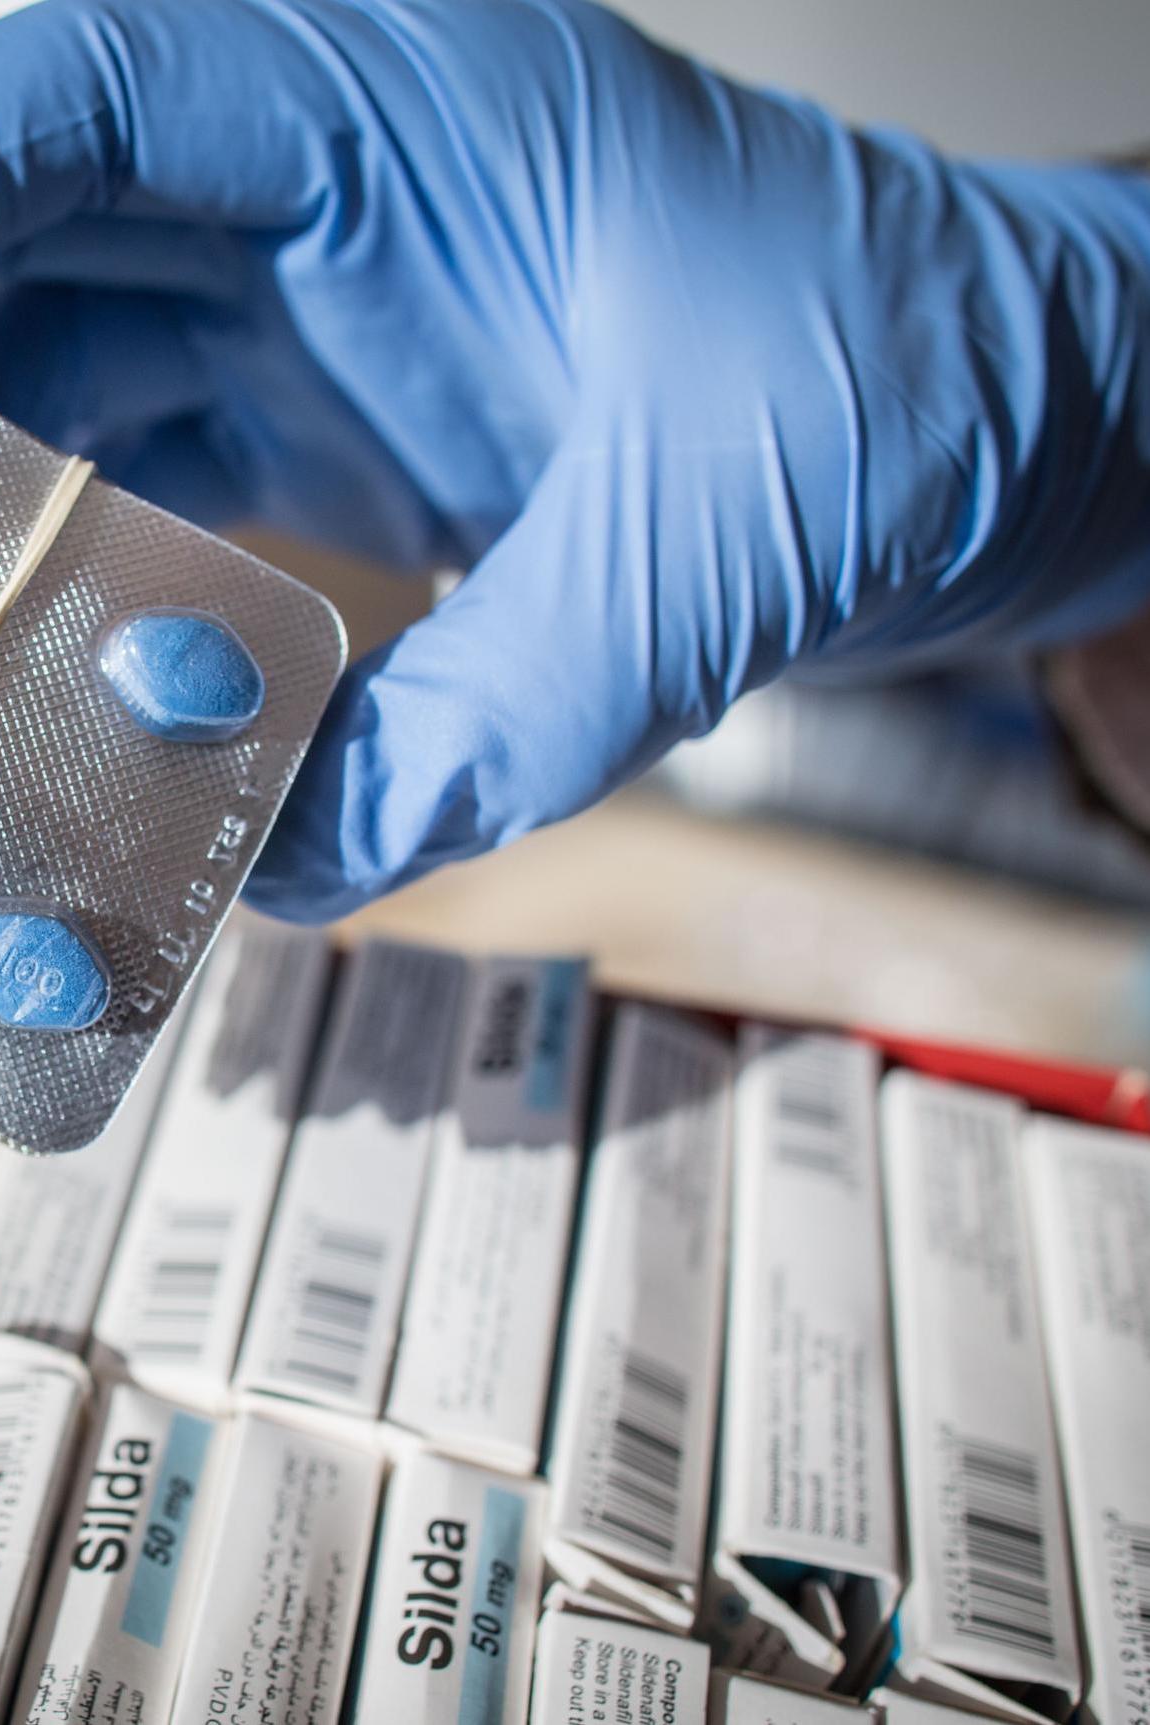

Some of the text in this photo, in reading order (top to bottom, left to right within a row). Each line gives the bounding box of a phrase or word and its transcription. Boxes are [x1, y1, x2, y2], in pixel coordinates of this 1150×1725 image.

[72, 1438, 153, 1573] Silda
[142, 1475, 192, 1567] 50 mg
[397, 1518, 468, 1671] Silda
[470, 1559, 516, 1657] 50 mg
[569, 1636, 592, 1681] Keep
[569, 1685, 585, 1712] out
[593, 1641, 614, 1721] Store in a
[616, 1646, 638, 1725] Sildenafil
